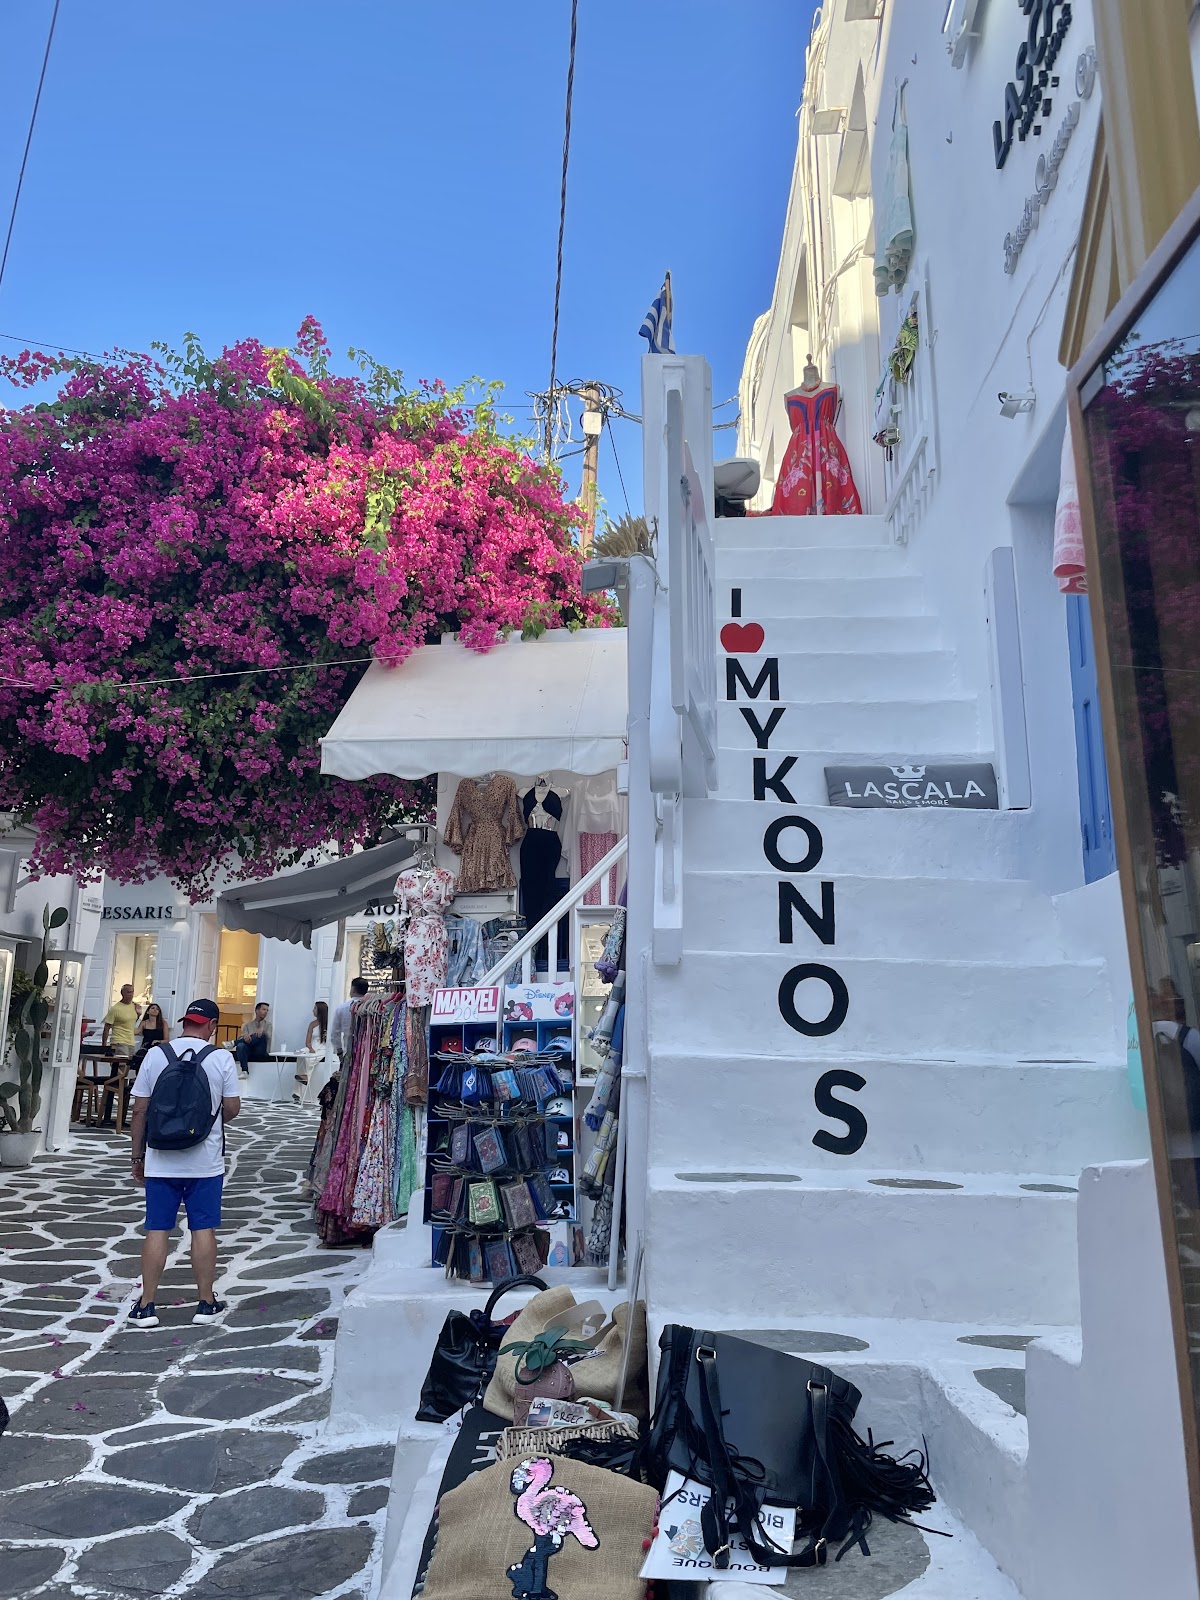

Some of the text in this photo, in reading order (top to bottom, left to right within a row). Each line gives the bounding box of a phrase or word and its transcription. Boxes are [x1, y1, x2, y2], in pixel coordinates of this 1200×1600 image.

[844, 780, 986, 800] LASCALA
[726, 588, 868, 1156] I MYKONOS
[435, 989, 496, 1014] MARVEL
[671, 1557, 771, 1573] BOUQUE
